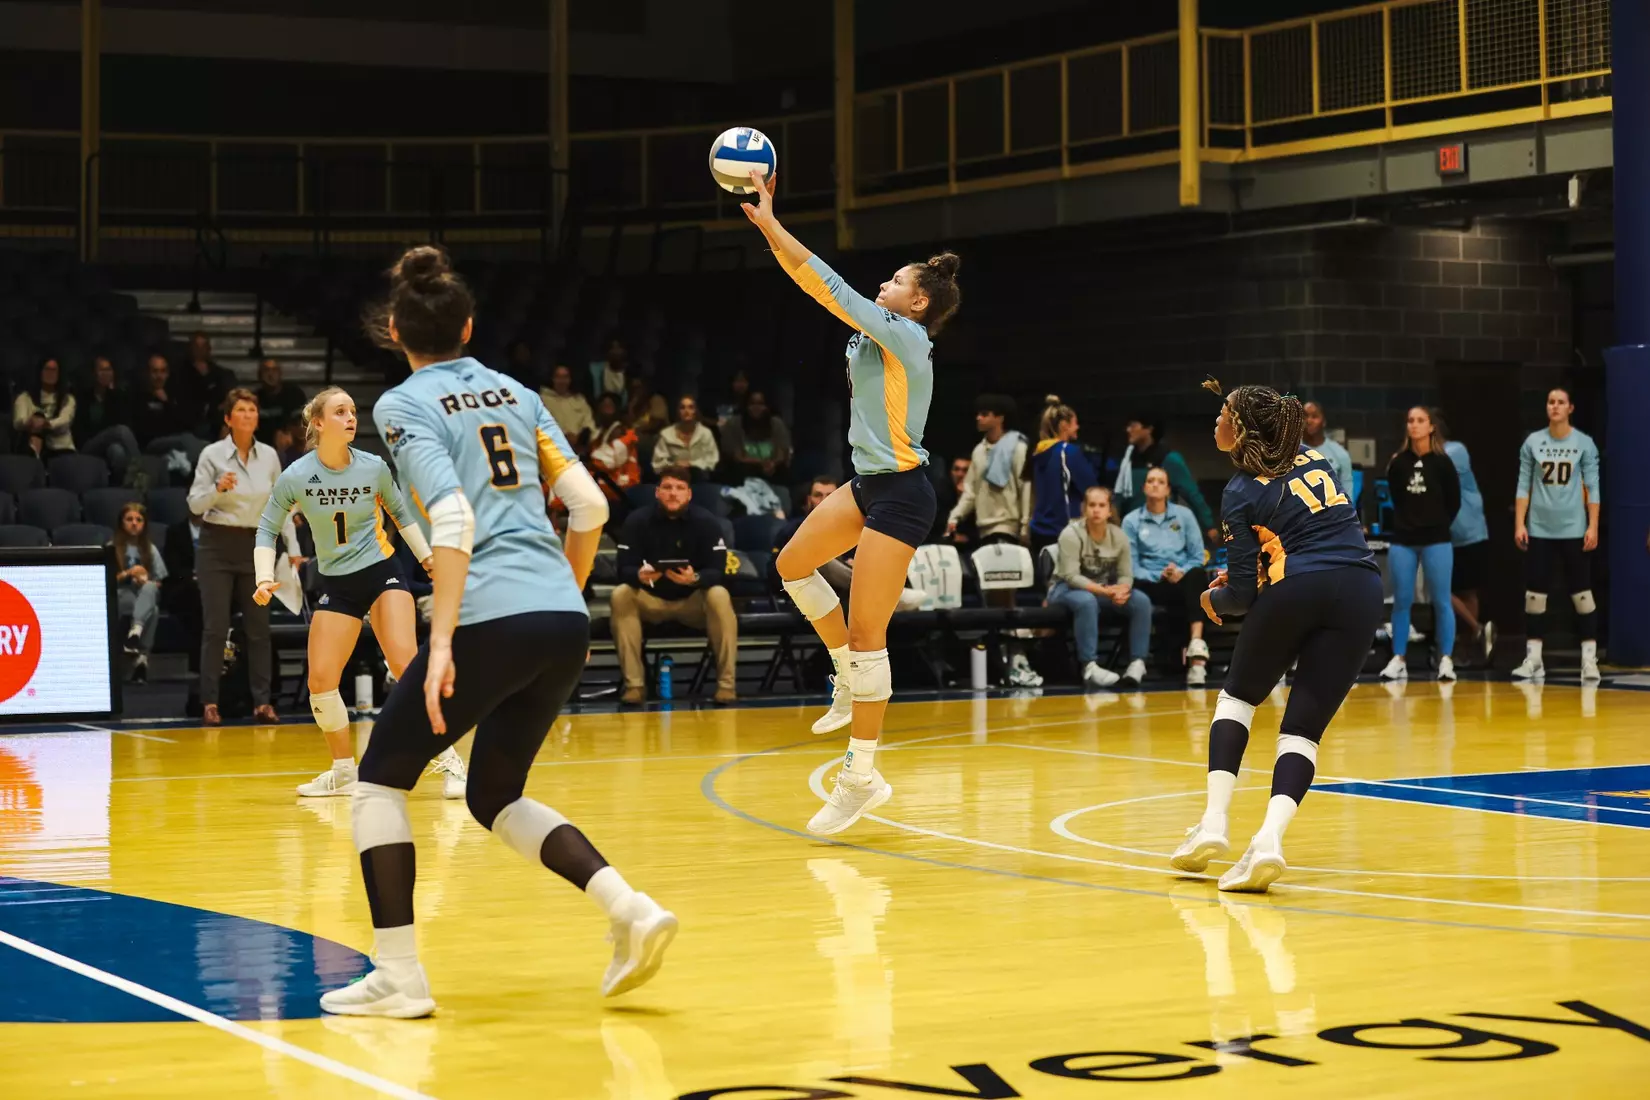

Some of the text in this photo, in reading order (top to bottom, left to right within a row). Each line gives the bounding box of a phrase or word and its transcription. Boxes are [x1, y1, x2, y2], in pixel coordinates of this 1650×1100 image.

[440, 387, 519, 415] ROOS
[478, 423, 521, 491] 6
[1541, 460, 1573, 486] 20
[305, 486, 371, 497] KANSAS
[319, 496, 358, 506] CITY
[1288, 469, 1348, 514] 12
[332, 510, 348, 547] 1
